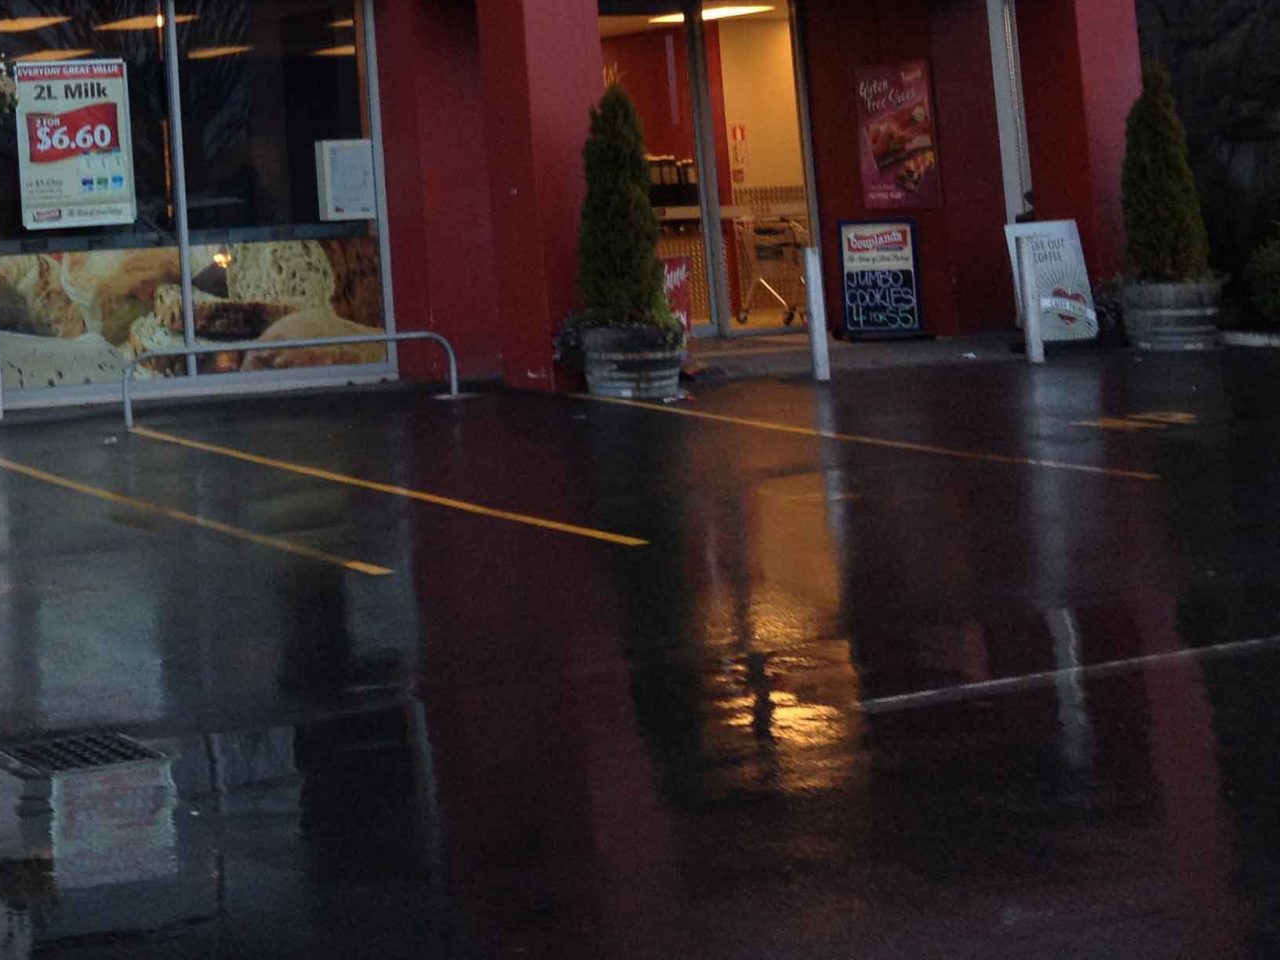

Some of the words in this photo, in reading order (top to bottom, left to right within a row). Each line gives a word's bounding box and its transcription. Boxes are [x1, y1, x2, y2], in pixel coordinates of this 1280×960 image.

[18, 67, 60, 77] EVERYDAY
[63, 66, 90, 75] GREAT
[93, 65, 118, 74] VALUE
[34, 84, 57, 100] 2L
[64, 82, 108, 99] Milk
[37, 124, 111, 151] $6.60
[846, 270, 904, 288] JUMBO
[846, 287, 917, 308] COOKIES
